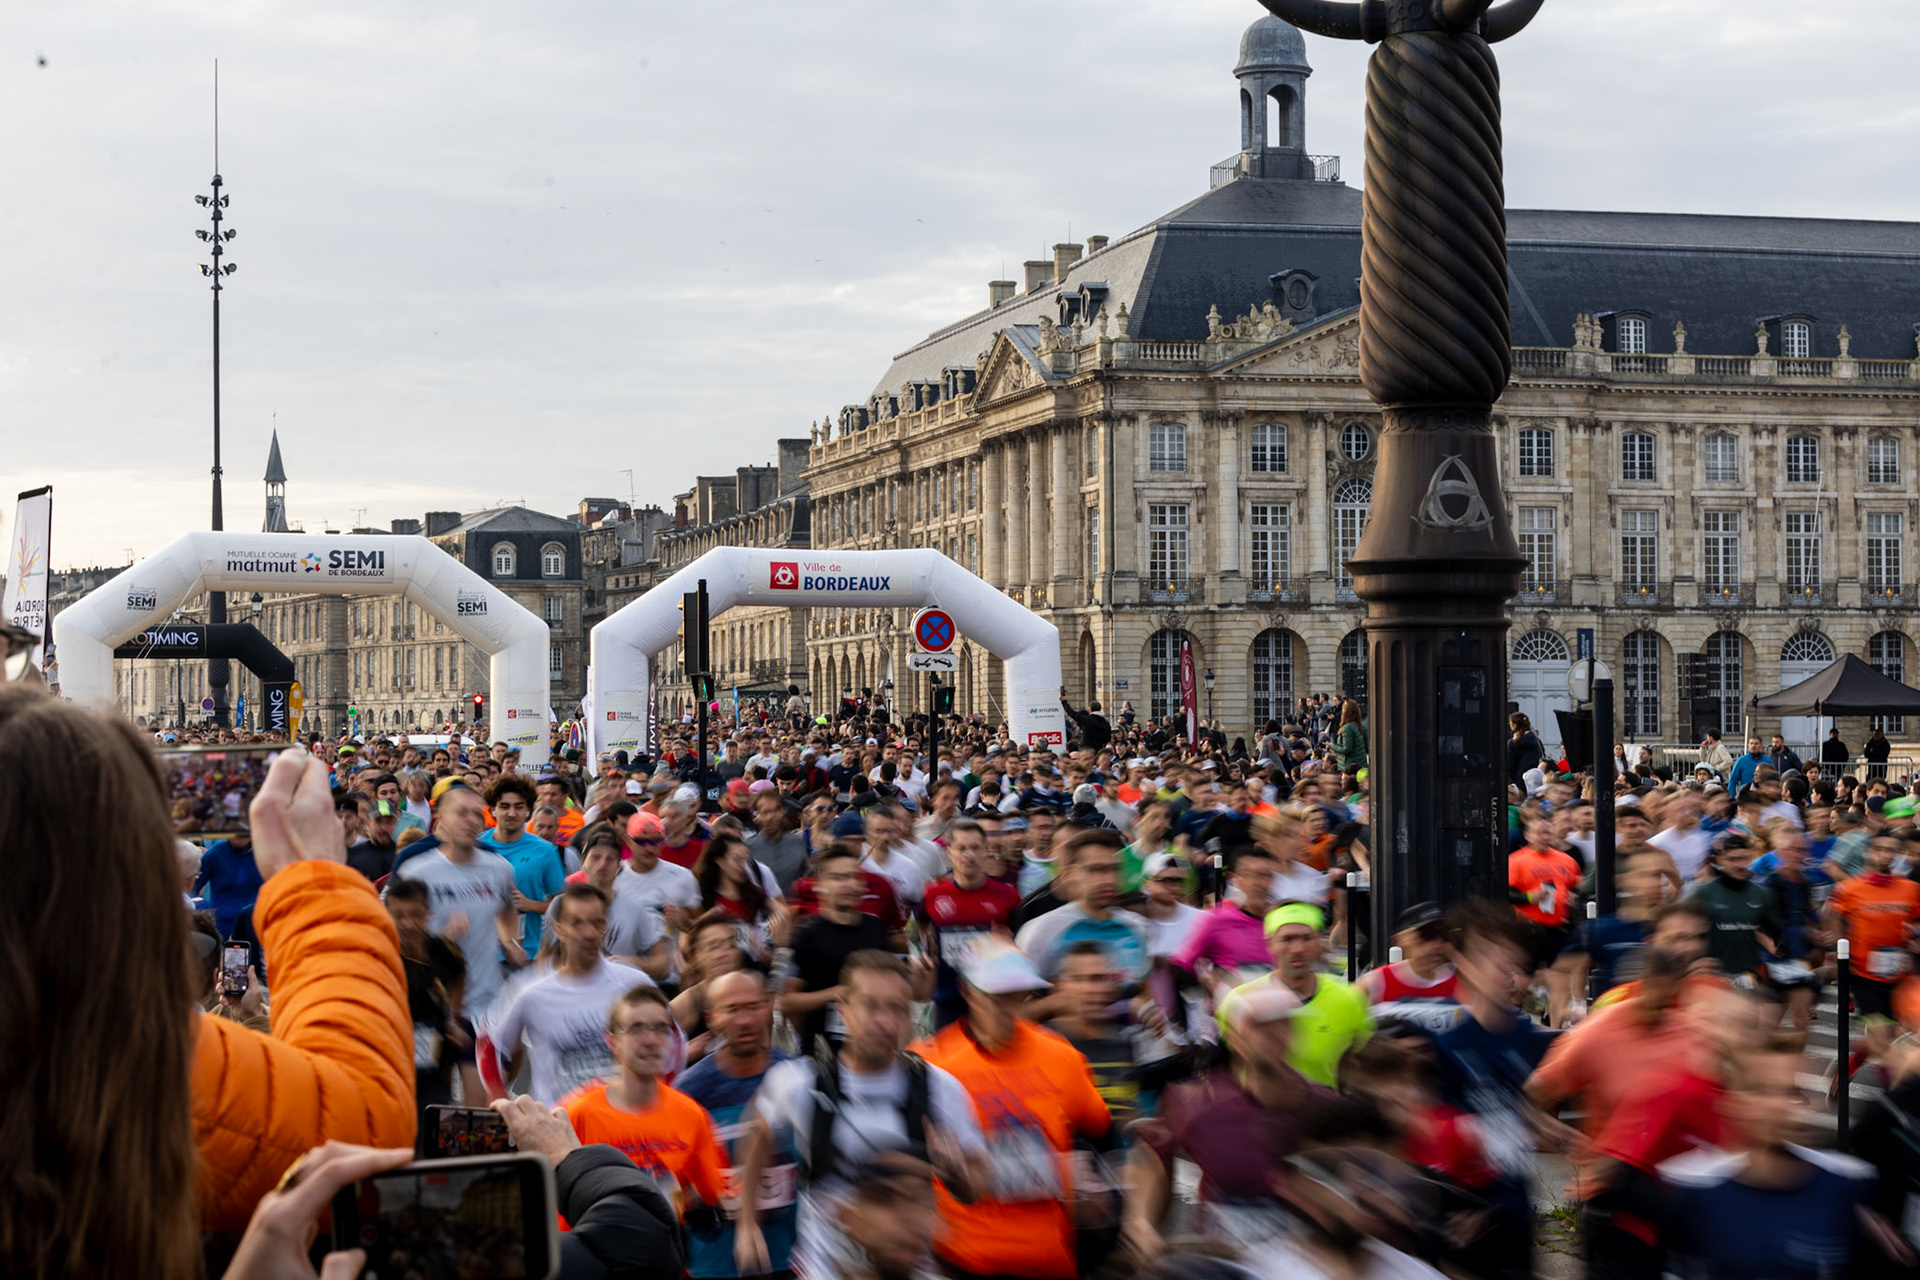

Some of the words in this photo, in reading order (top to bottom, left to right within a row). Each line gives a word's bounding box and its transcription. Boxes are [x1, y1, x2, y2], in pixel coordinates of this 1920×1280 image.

[227, 558, 298, 572] matmut
[328, 550, 384, 569] SEMI
[341, 569, 384, 577] BORDEAUX
[803, 562, 826, 572] Ville
[829, 562, 842, 572] de
[803, 576, 891, 591] BORDEAUX
[127, 596, 157, 608] SEMI
[457, 601, 488, 613] SEMI
